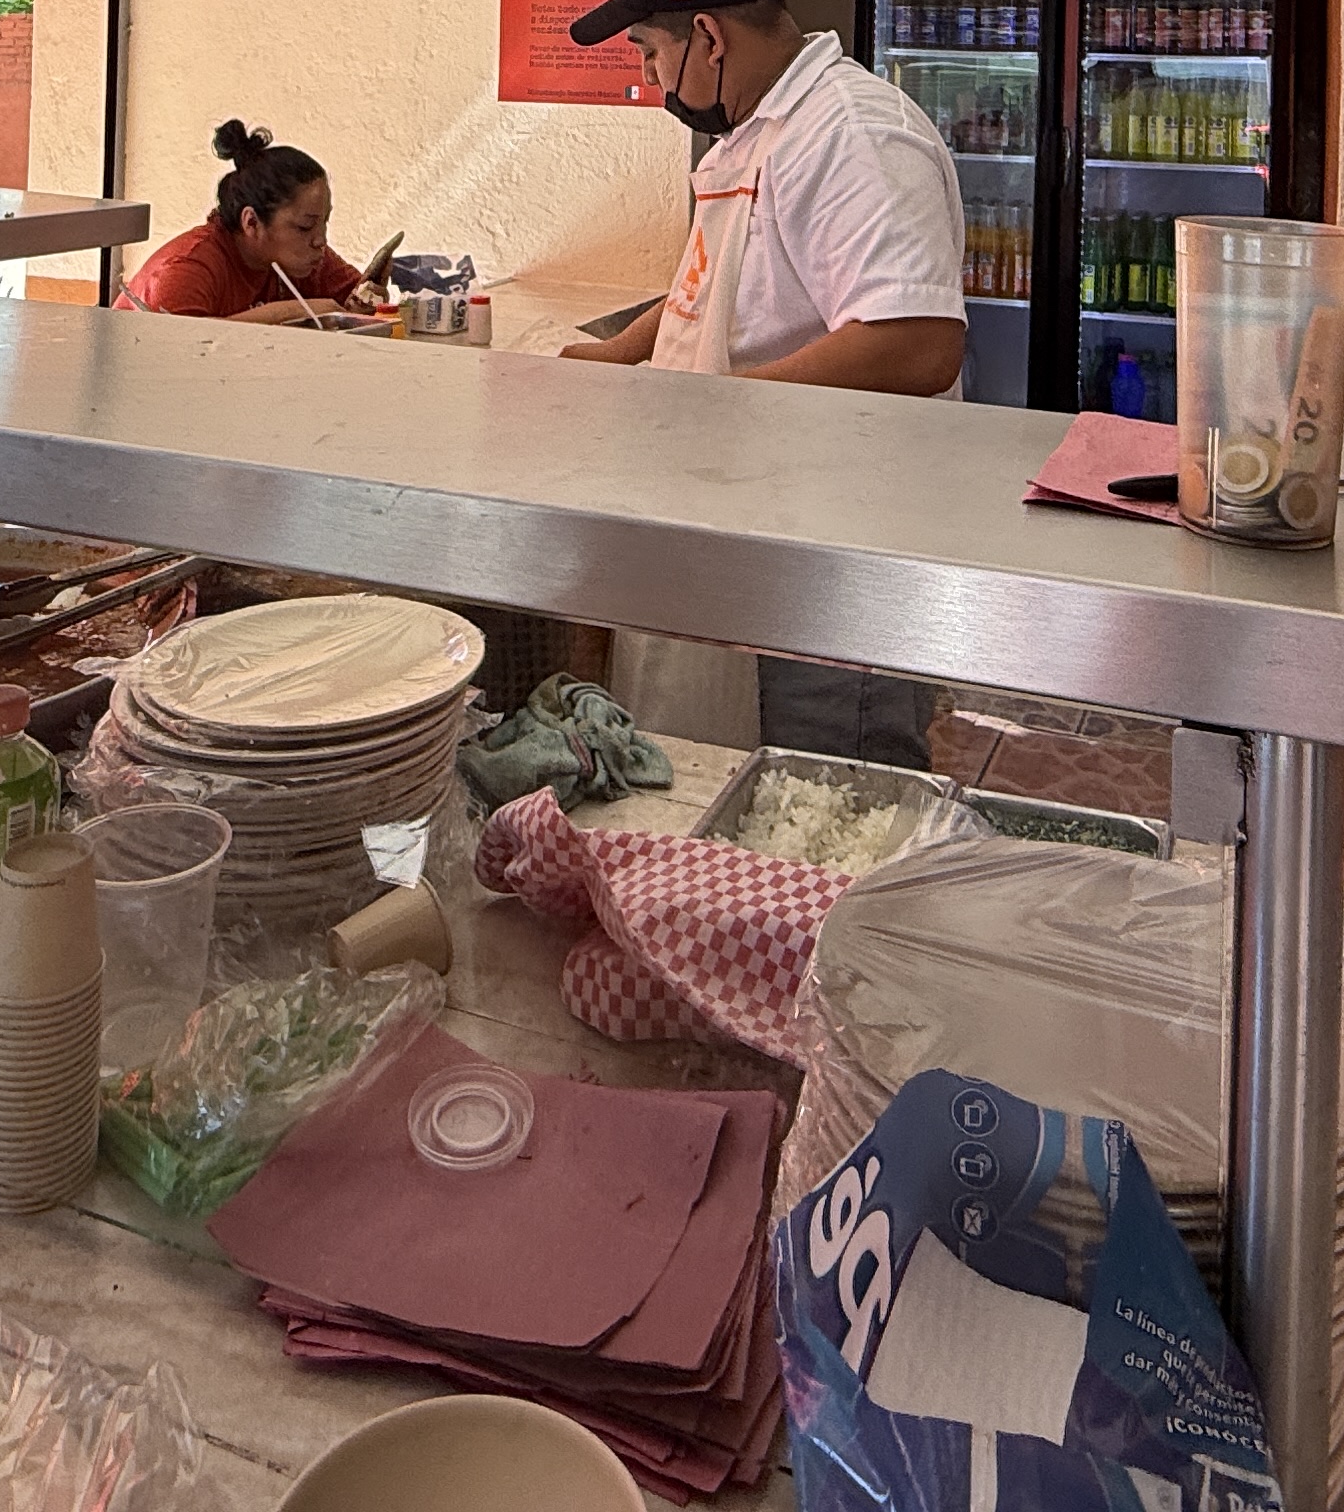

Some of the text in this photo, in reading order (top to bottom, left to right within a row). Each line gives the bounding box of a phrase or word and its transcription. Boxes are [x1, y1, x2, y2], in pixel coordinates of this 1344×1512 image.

[1115, 1298, 1134, 1322] La
[1136, 1310, 1177, 1345] línea
[1124, 1352, 1154, 1371] dar
